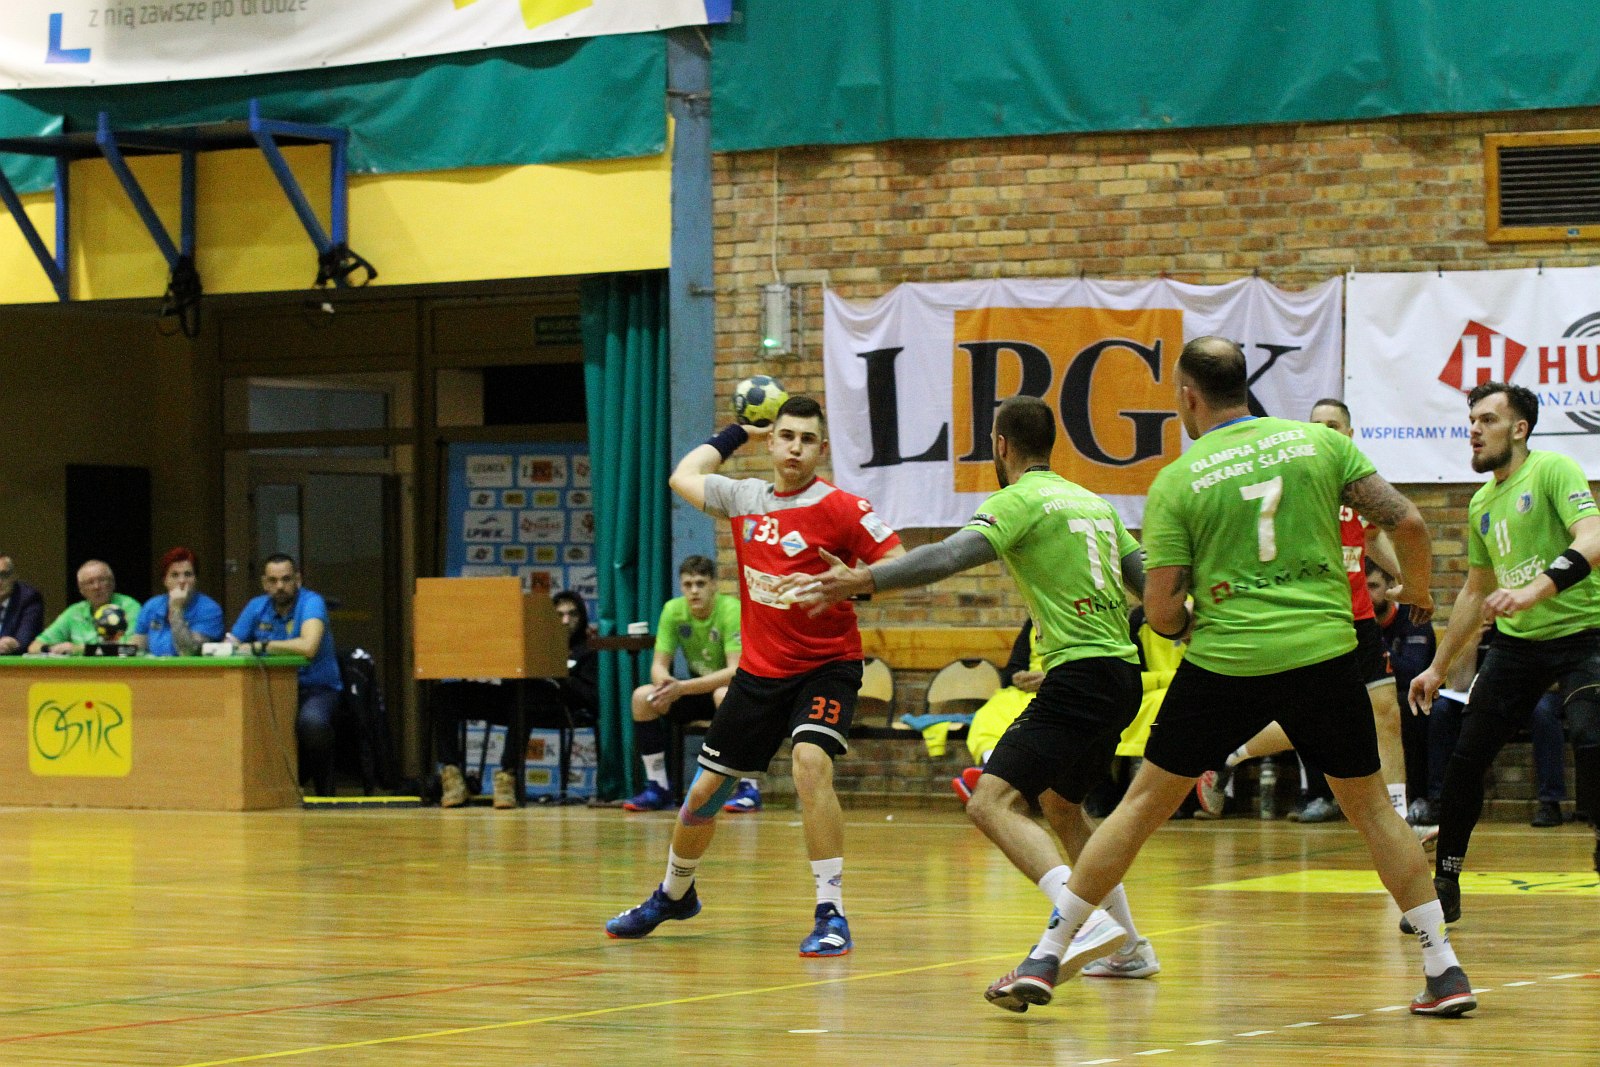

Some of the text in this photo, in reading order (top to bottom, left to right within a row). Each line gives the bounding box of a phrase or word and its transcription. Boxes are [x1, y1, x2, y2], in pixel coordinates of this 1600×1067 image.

[88, 9, 99, 28] z
[104, 7, 135, 29] nią
[140, 2, 207, 25] zawsze
[212, 0, 234, 25] po
[1361, 426, 1446, 440] WSPIERAMY
[1190, 444, 1256, 473] OLIMPIA
[1191, 460, 1254, 493] PIEKARY
[754, 515, 780, 546] 33
[1239, 475, 1283, 562] 7
[1494, 518, 1511, 558] 11
[1067, 517, 1121, 591] 77
[808, 696, 842, 725] 33
